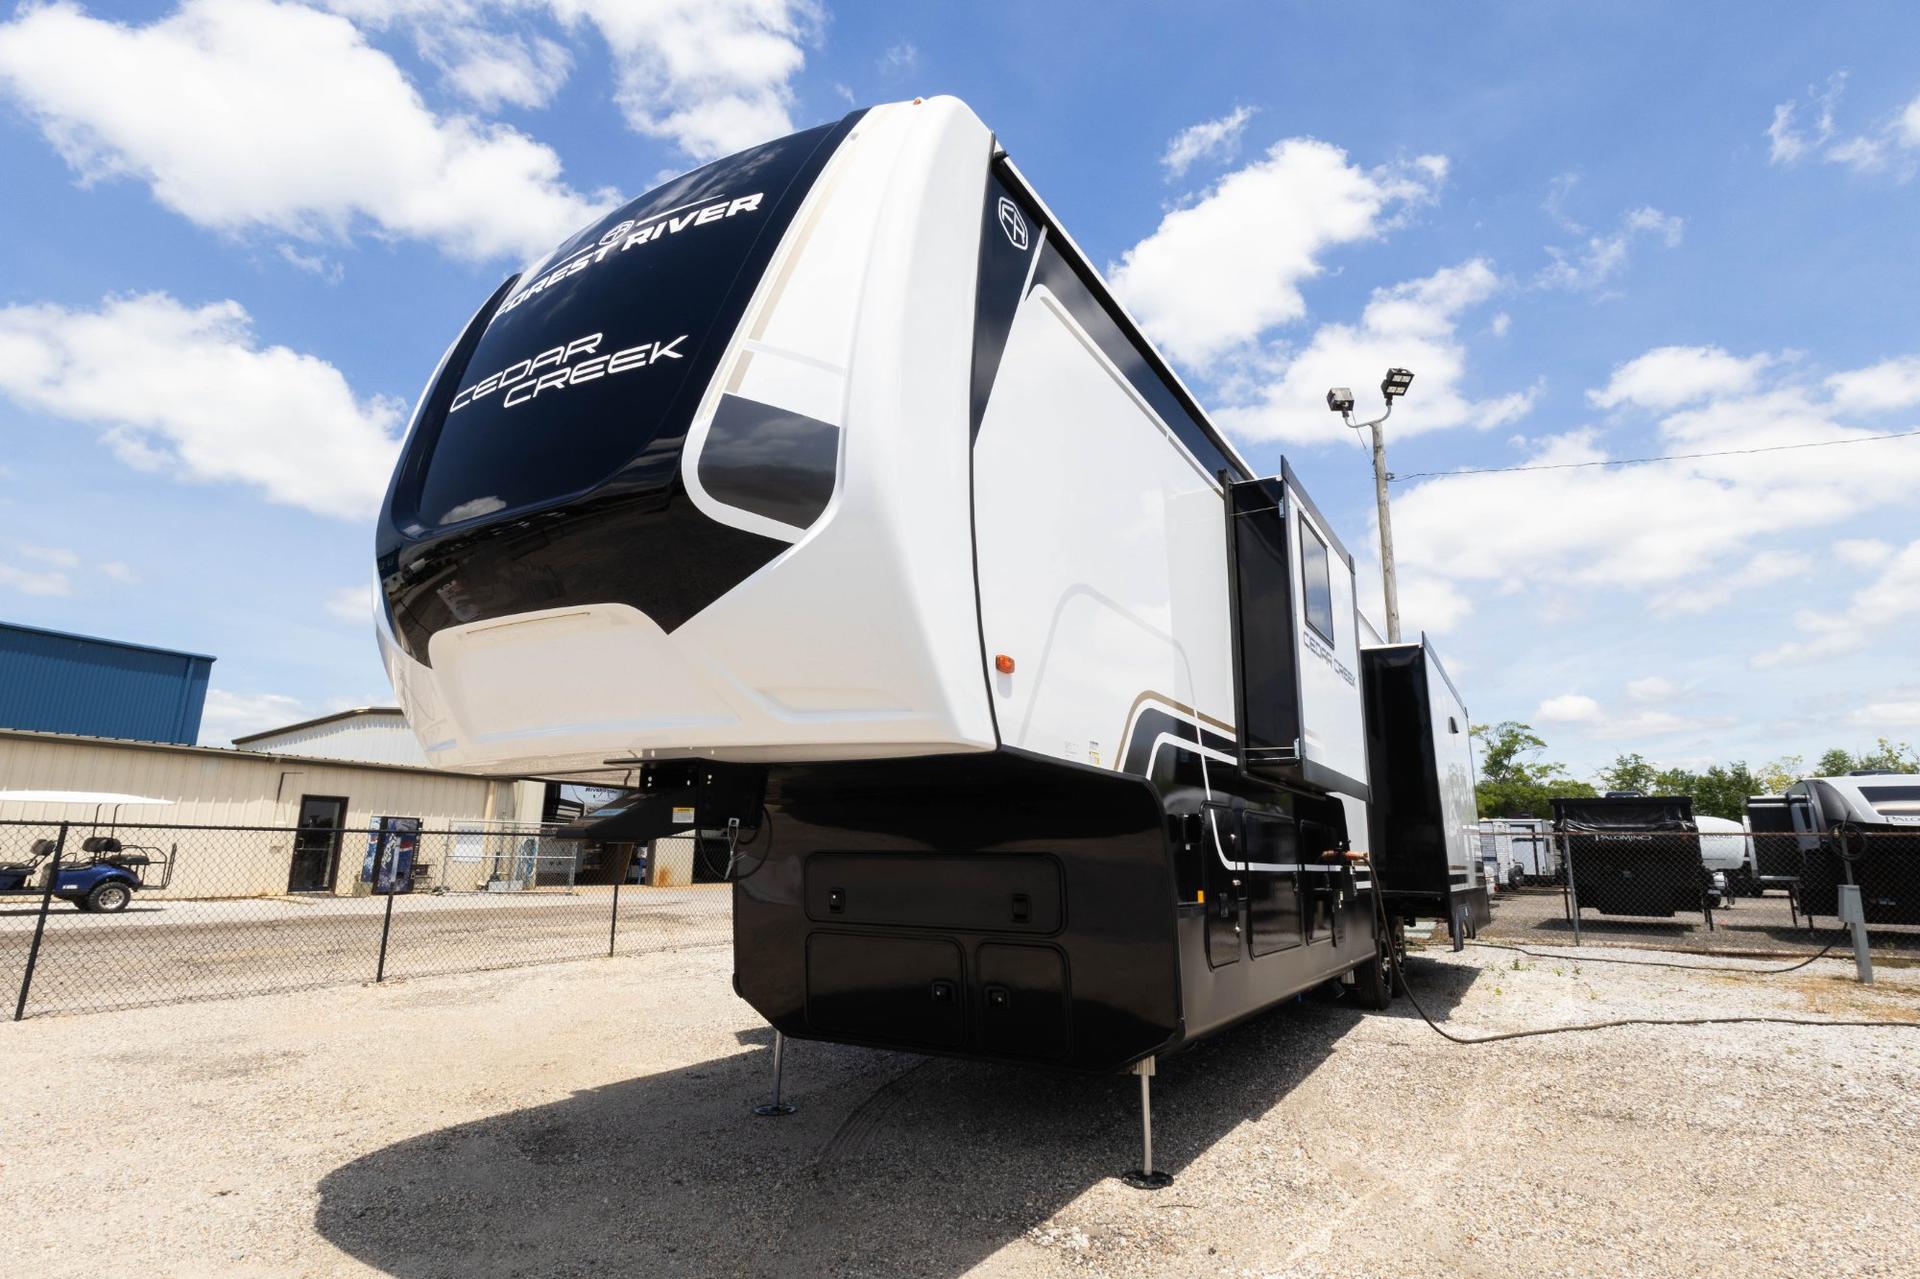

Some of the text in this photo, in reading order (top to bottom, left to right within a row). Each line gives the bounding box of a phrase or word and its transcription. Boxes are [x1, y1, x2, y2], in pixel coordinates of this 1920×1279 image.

[489, 192, 764, 325] FOREST RIVER
[450, 332, 603, 413] CEDAR
[504, 334, 689, 409] CREEK
[1303, 630, 1356, 689] CEDAR CREEK
[1594, 834, 1652, 842] PALOMINO
